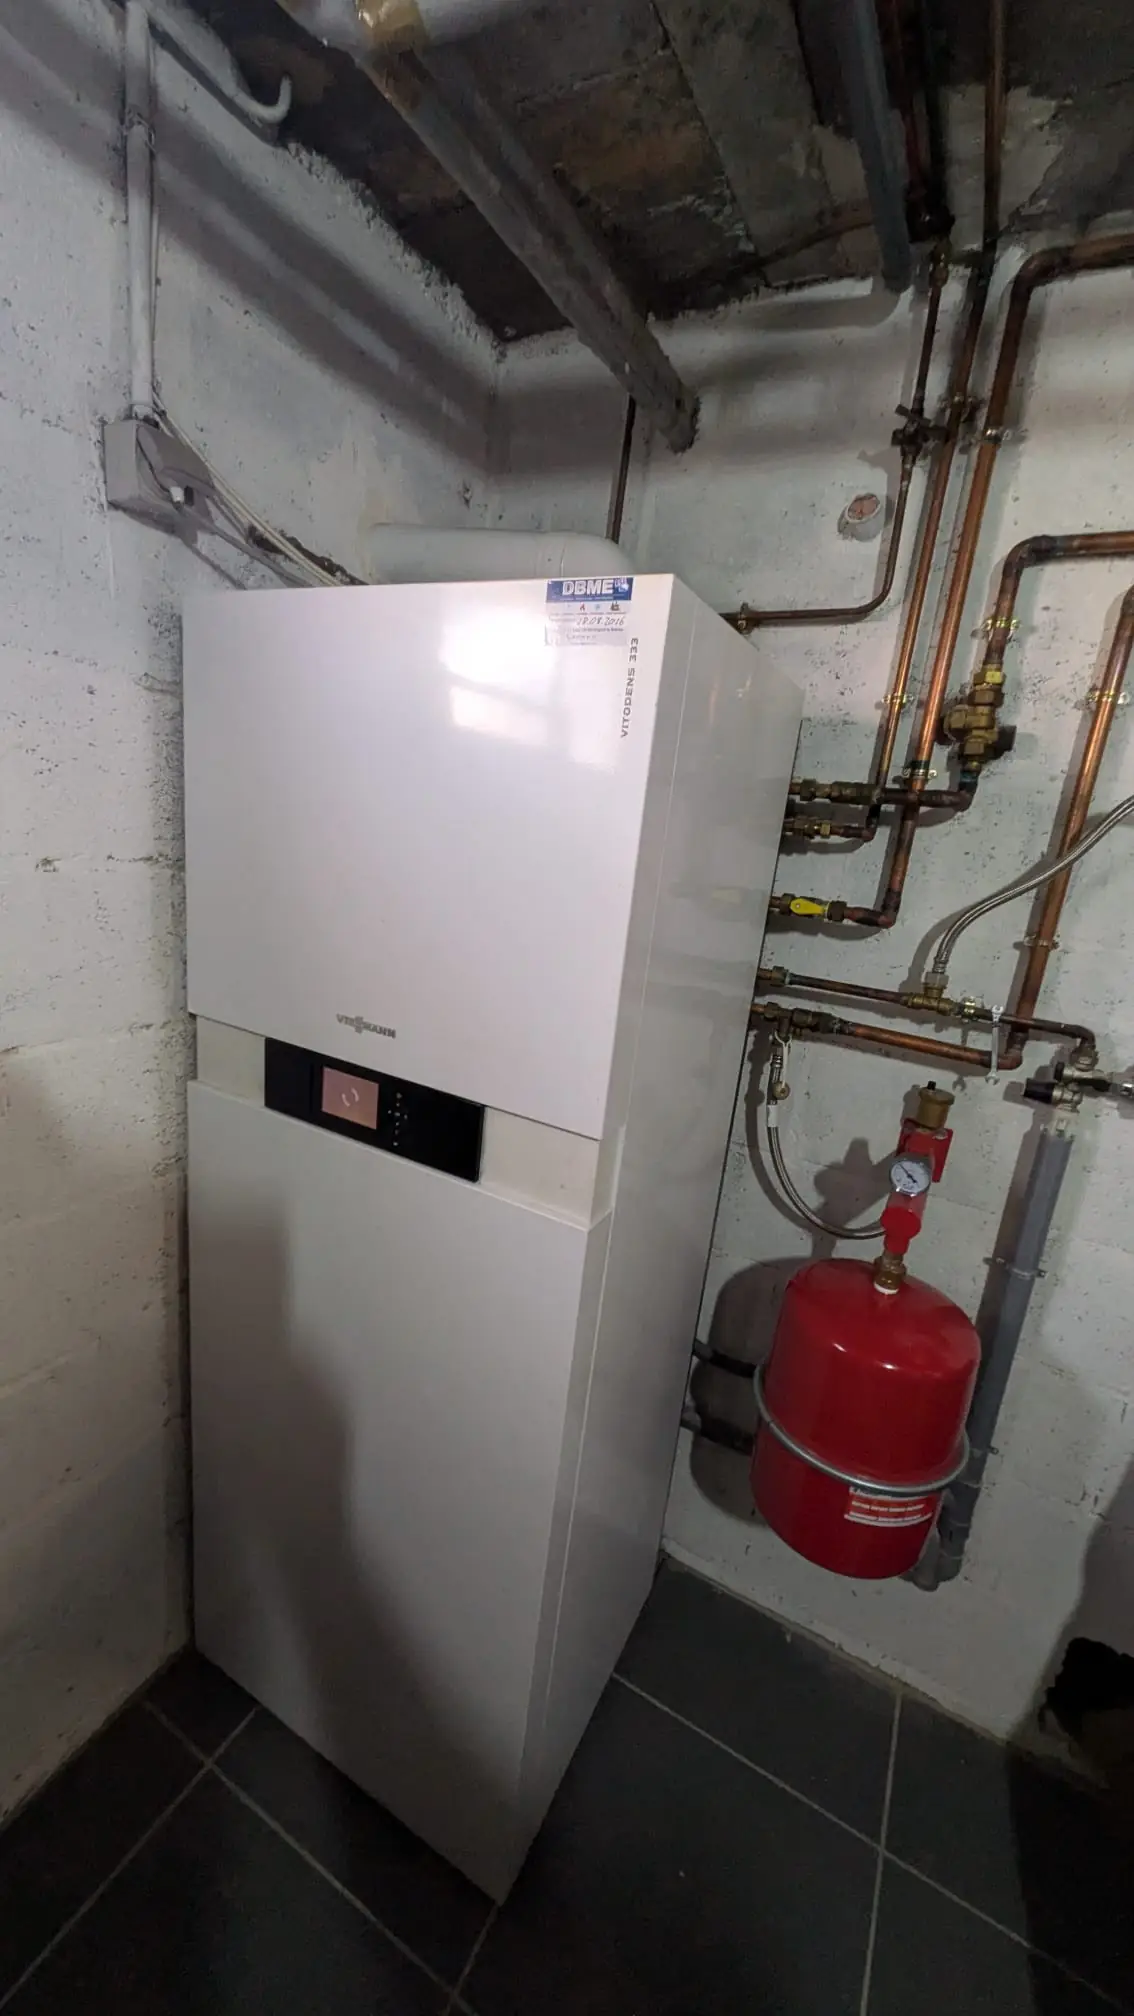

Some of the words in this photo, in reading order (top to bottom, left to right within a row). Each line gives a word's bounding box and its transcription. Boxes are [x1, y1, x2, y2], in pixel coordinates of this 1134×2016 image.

[562, 579, 614, 595] DBME
[620, 667, 636, 738] VITODENS
[629, 637, 639, 662] 333
